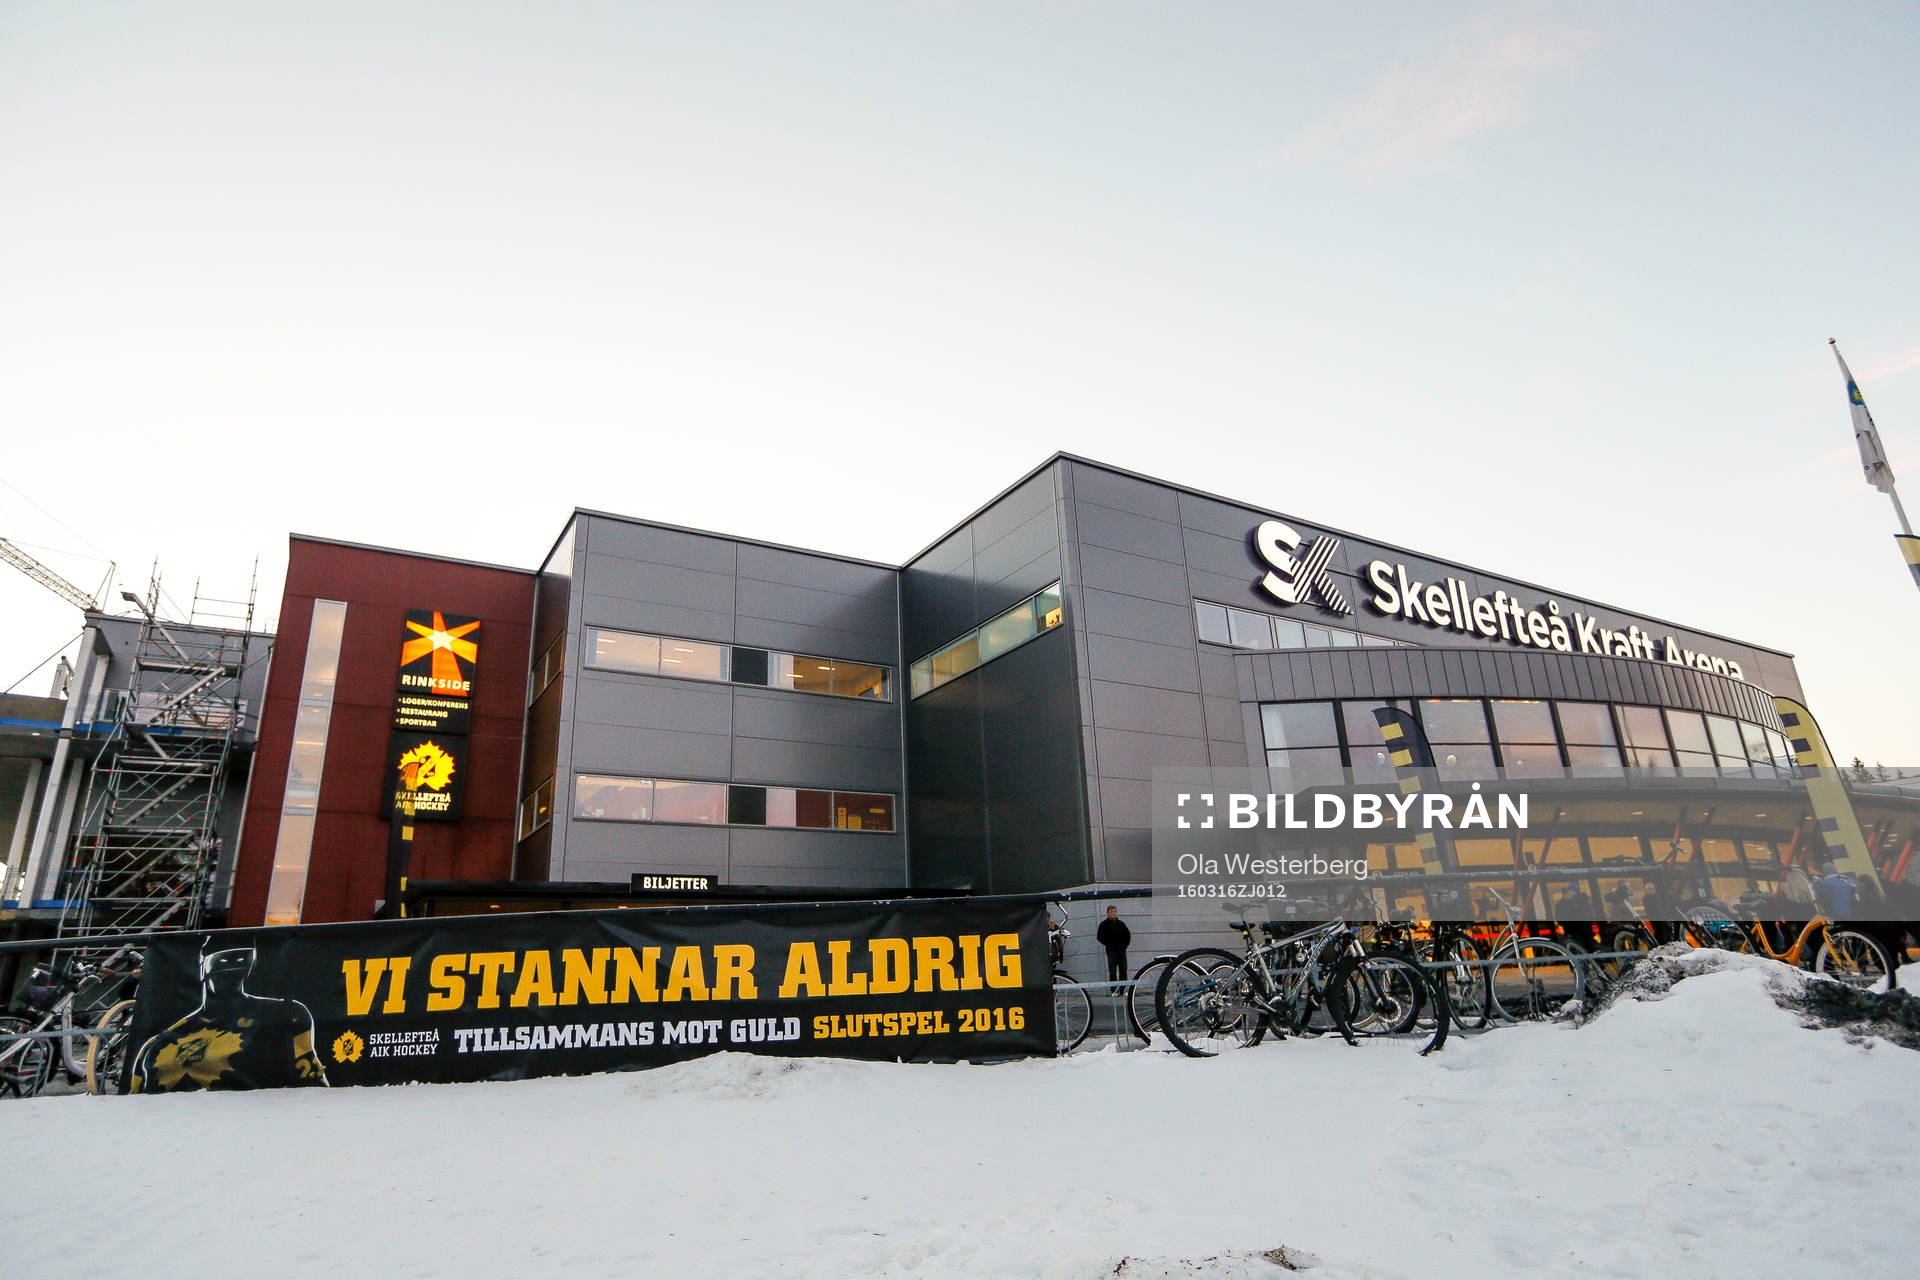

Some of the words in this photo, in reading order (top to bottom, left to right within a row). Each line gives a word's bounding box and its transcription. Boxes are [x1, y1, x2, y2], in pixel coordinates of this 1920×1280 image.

[1368, 559, 1572, 652] Skellefteå
[1573, 612, 1655, 661] Kraft
[1665, 635, 1745, 681] Arena
[402, 674, 471, 691] RINKSIDE
[401, 707, 448, 718] RESTAURANG
[400, 717, 437, 727] SPORTBAR
[414, 801, 450, 811] HOCKEY
[643, 876, 709, 890] BILJETTER
[341, 955, 412, 1016] VI
[426, 943, 759, 1012] STANNAR
[778, 932, 1024, 999] ALDRIG
[369, 1028, 441, 1045] SKELLEFTEÅ
[453, 1021, 655, 1053] TILLSAMMANS
[661, 1019, 723, 1045] MOT
[730, 1017, 801, 1043] GULD
[813, 1010, 950, 1040] SLUTSPEL
[957, 1006, 1025, 1033] 2016
[369, 1046, 391, 1058] AIK
[393, 1043, 438, 1057] HOCKEY
